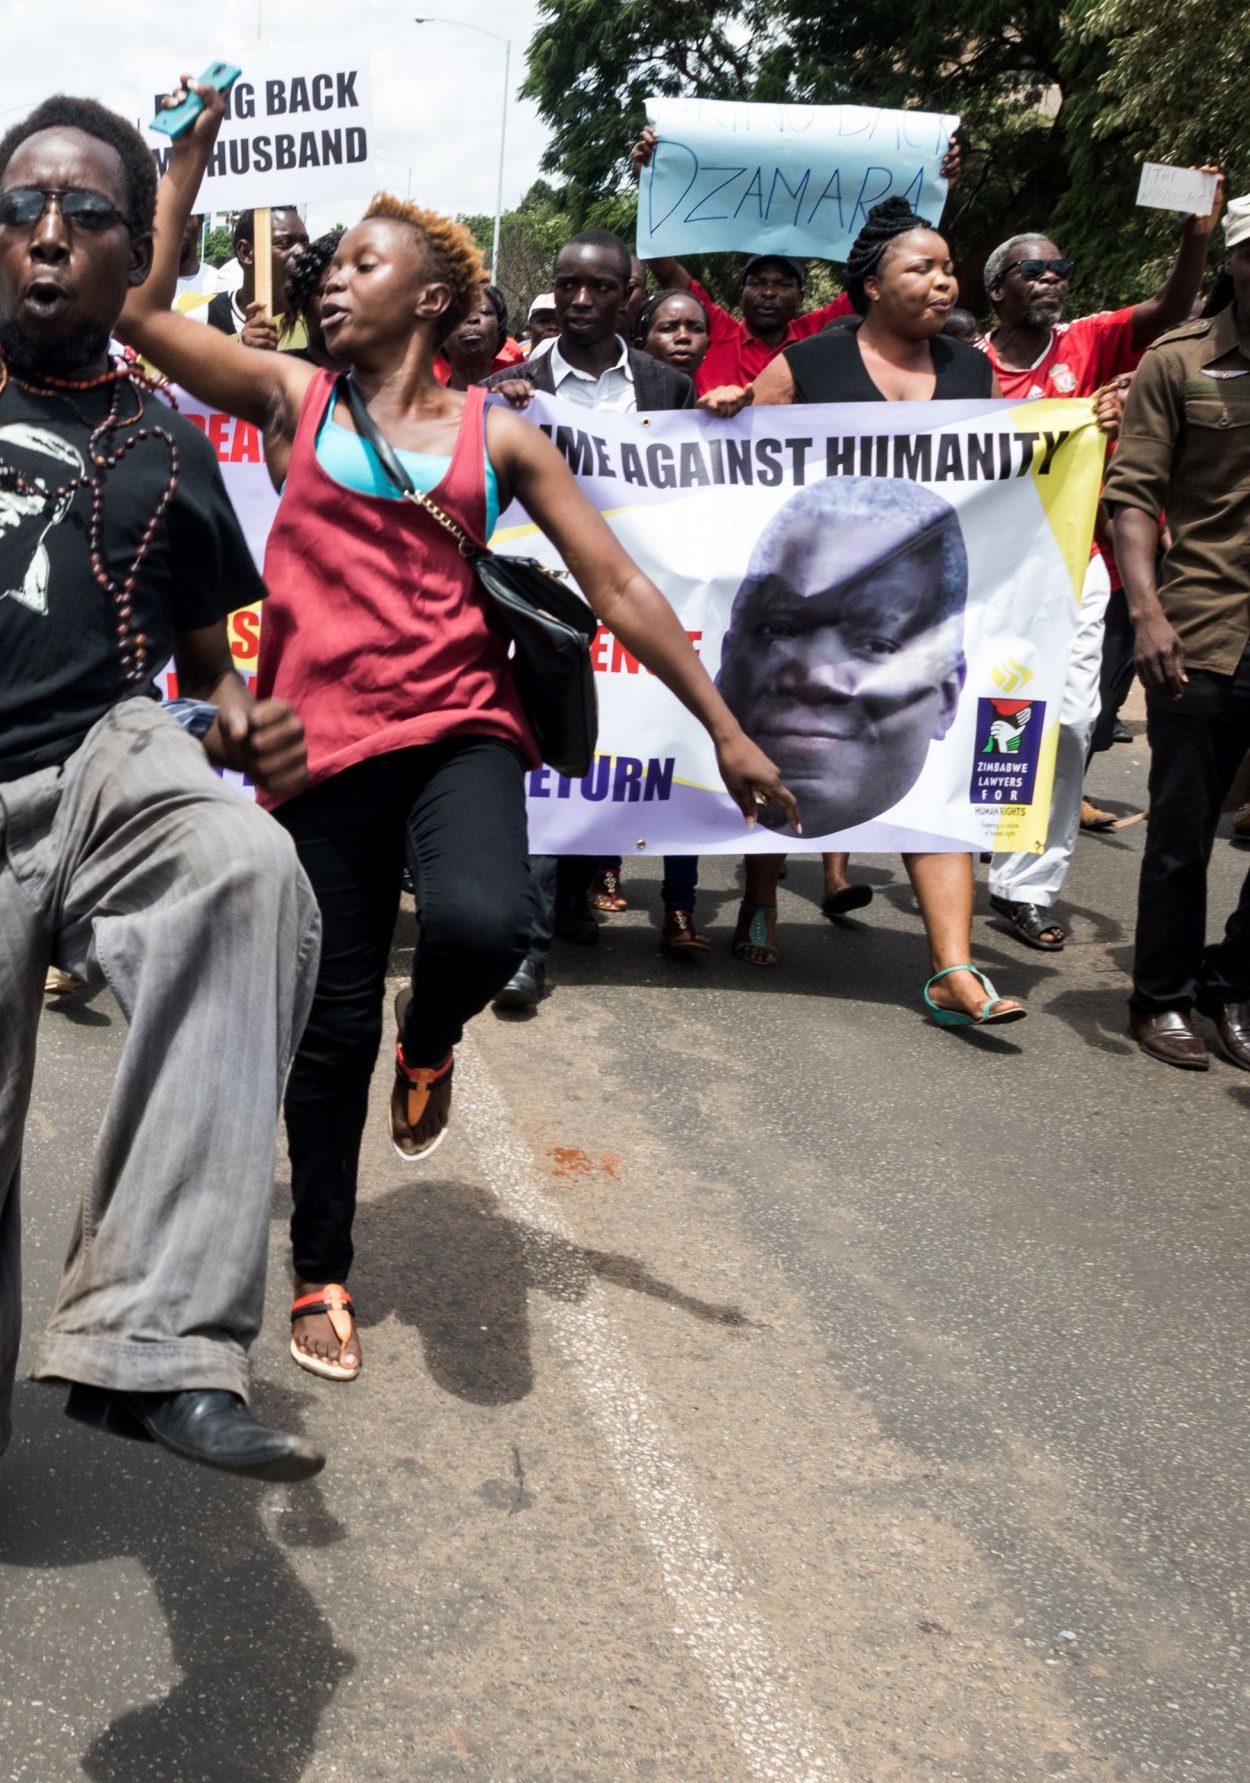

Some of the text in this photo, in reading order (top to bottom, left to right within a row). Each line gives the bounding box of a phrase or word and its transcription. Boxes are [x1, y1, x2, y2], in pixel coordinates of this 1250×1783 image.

[266, 71, 359, 116] BACK
[207, 127, 368, 178] HUSBAND
[649, 140, 925, 239] DZAMARA
[620, 437, 813, 489] AGAINST
[826, 430, 1071, 482] HUMANITY
[977, 762, 1028, 773] ZIMBABWE
[978, 777, 1023, 788] LAWYERS
[975, 807, 1026, 817] HUMAN RIGHTS
